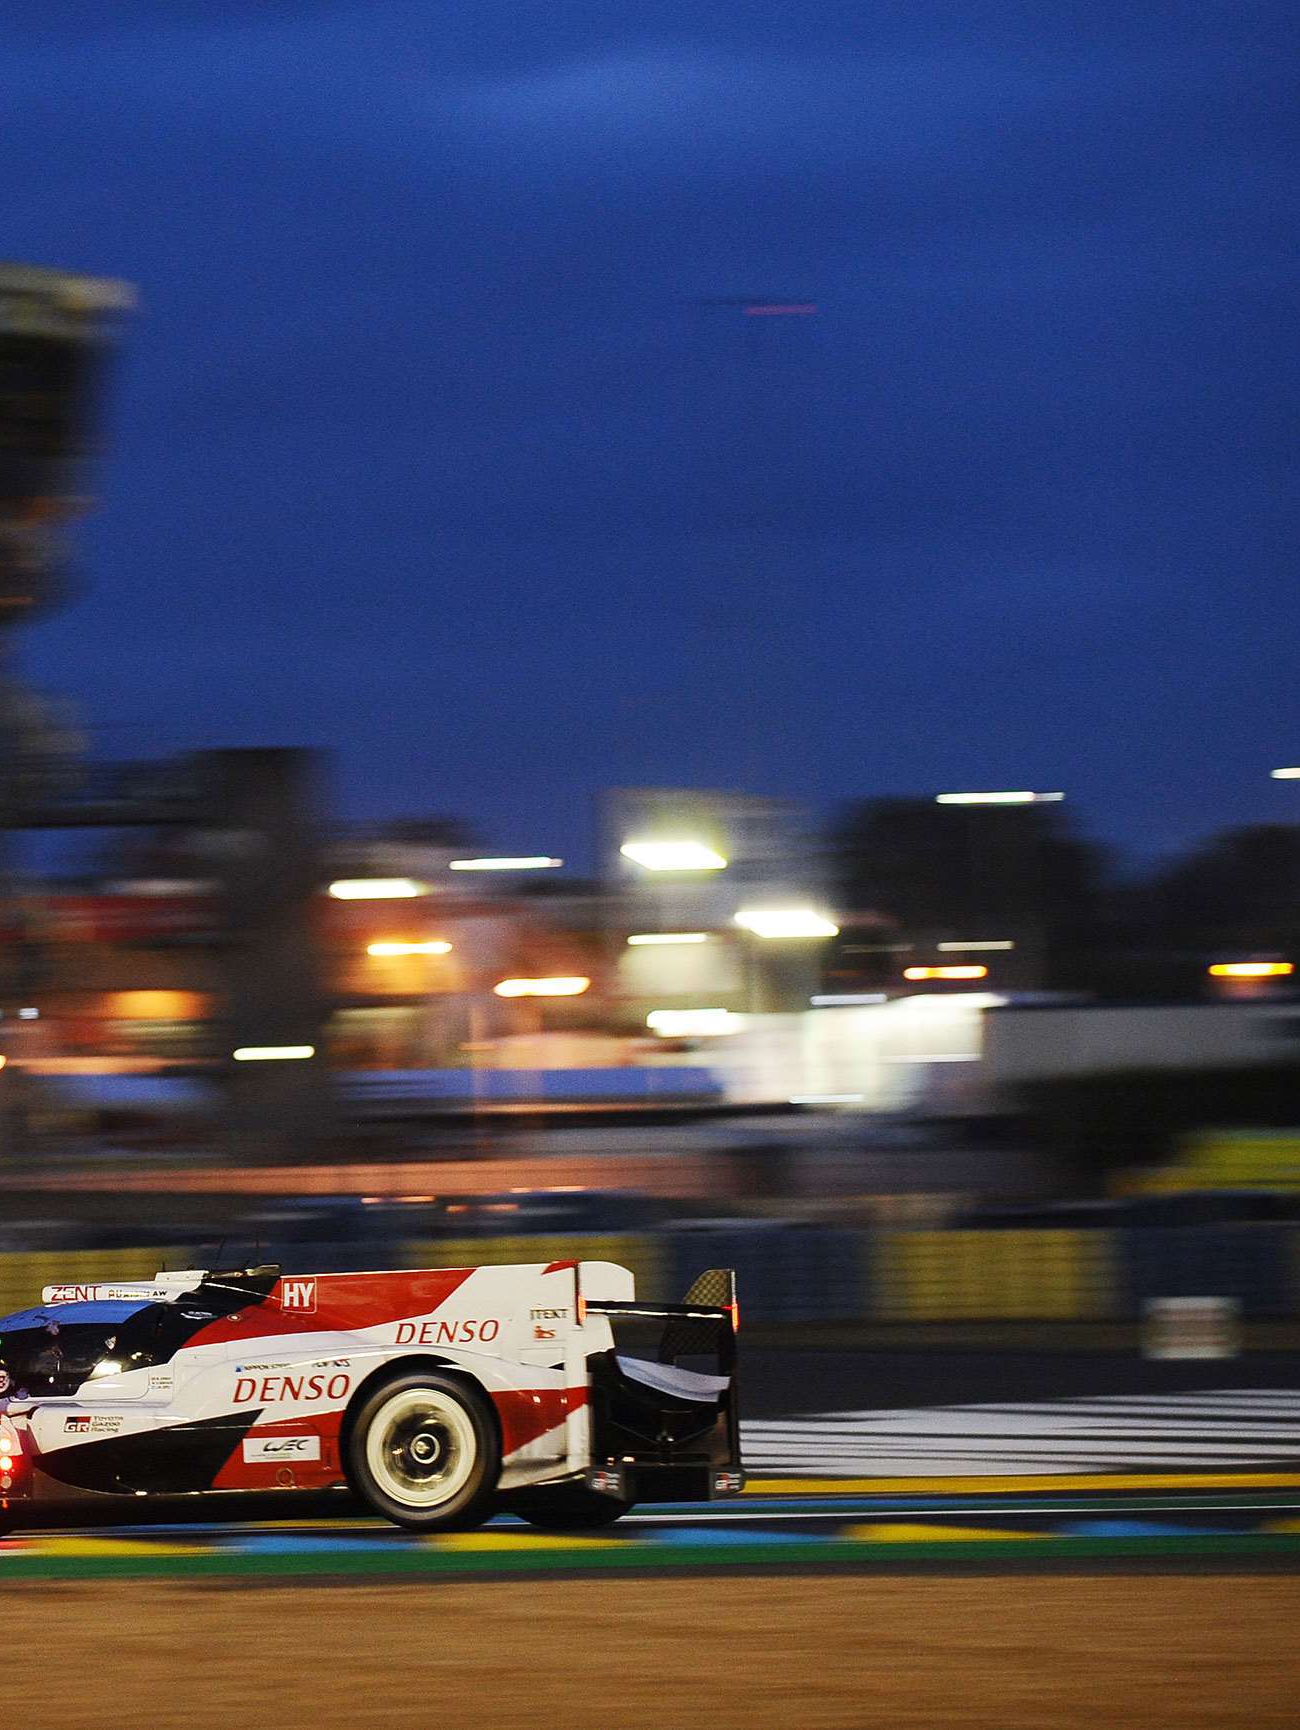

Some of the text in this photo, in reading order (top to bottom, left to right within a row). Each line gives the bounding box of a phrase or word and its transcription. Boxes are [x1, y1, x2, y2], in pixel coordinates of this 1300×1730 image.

[51, 1285, 102, 1300] ZENT
[284, 1283, 315, 1307] HY
[395, 1319, 499, 1344] DENSO
[233, 1374, 350, 1402] DENSO
[263, 1439, 309, 1451] WEC
